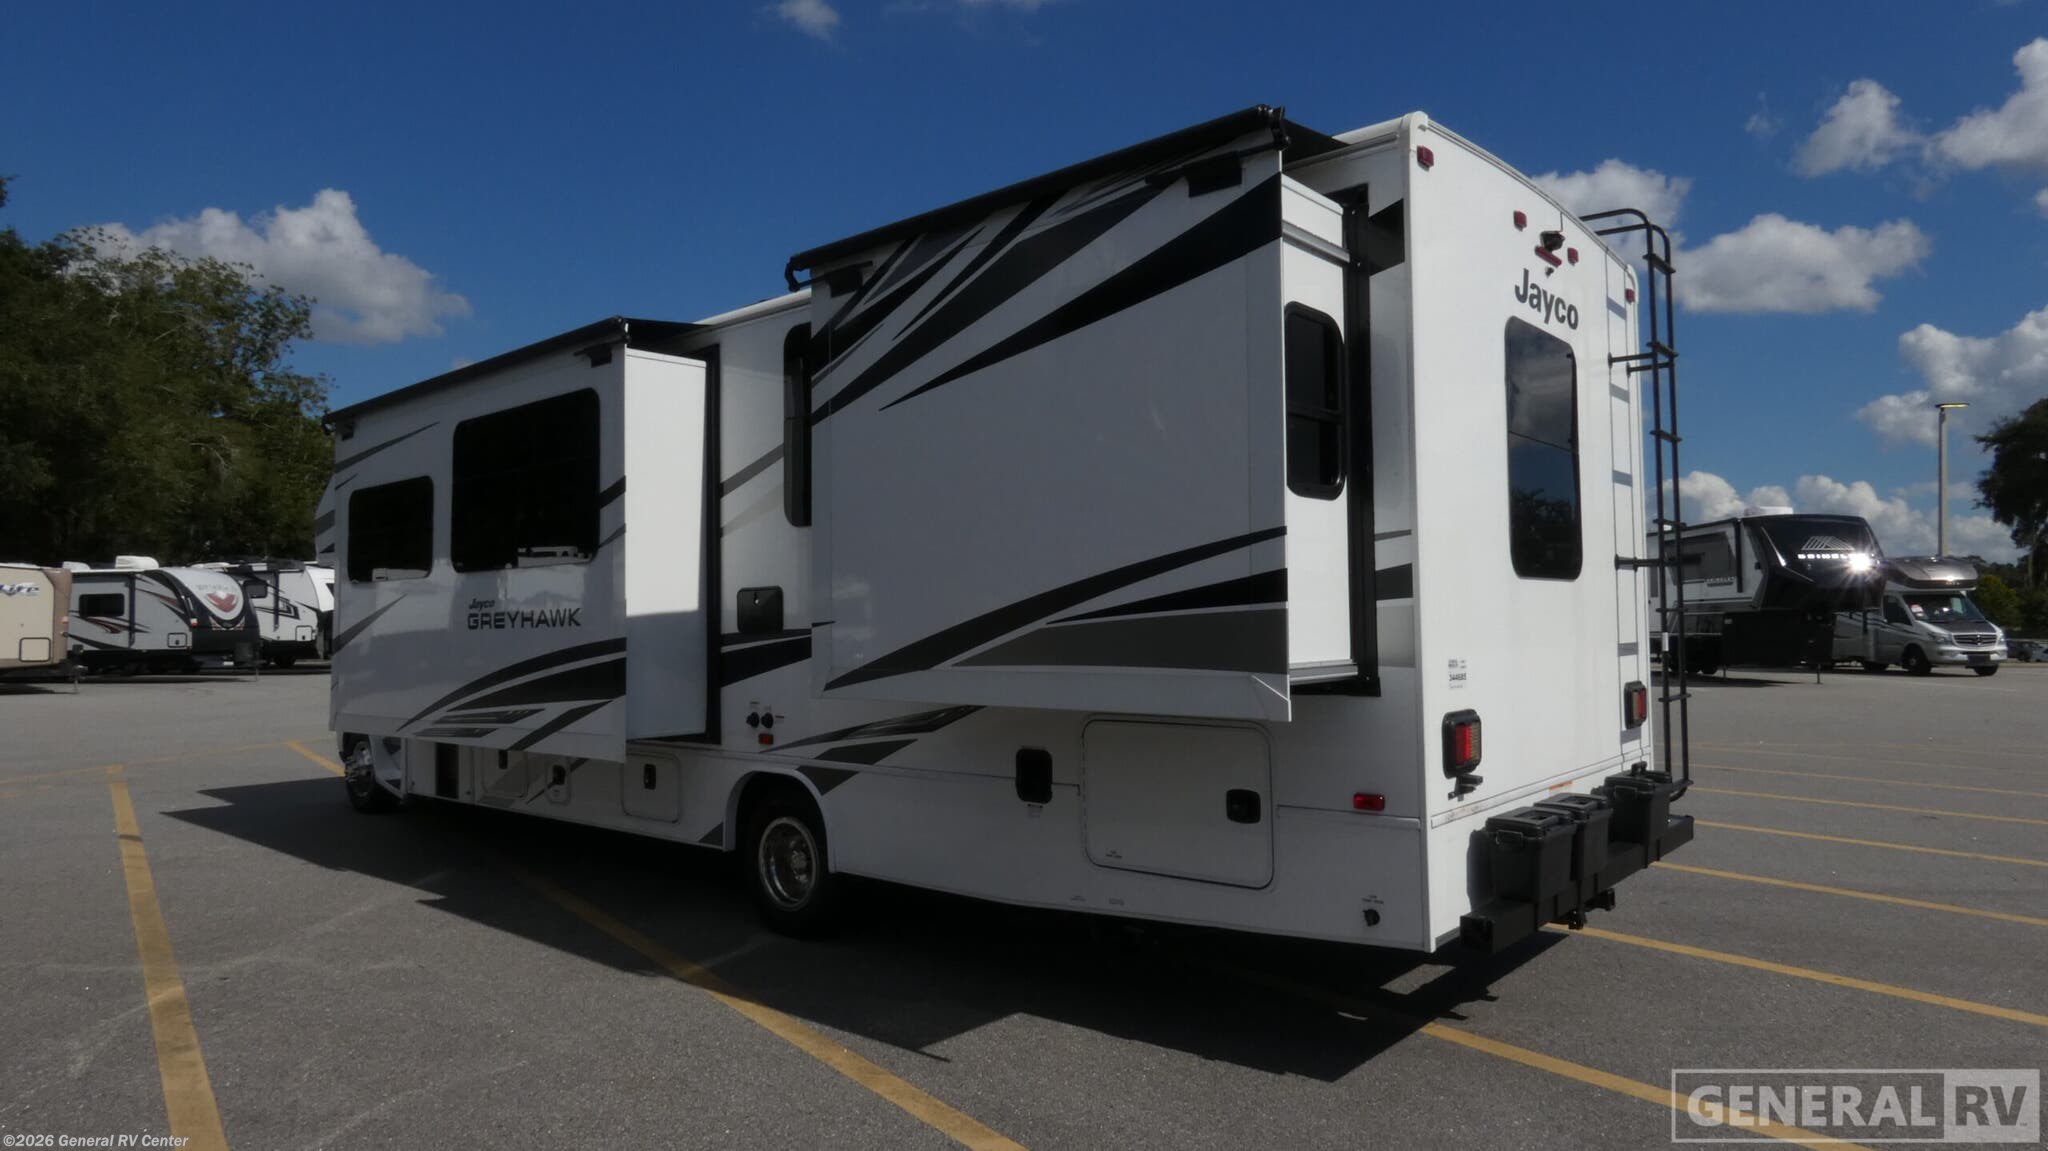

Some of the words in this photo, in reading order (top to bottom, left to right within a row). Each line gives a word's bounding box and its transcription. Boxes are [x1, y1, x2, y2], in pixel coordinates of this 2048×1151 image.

[1515, 268, 1578, 330] Jayco
[469, 599, 496, 612] Jayco
[467, 608, 581, 630] GREYHAWK
